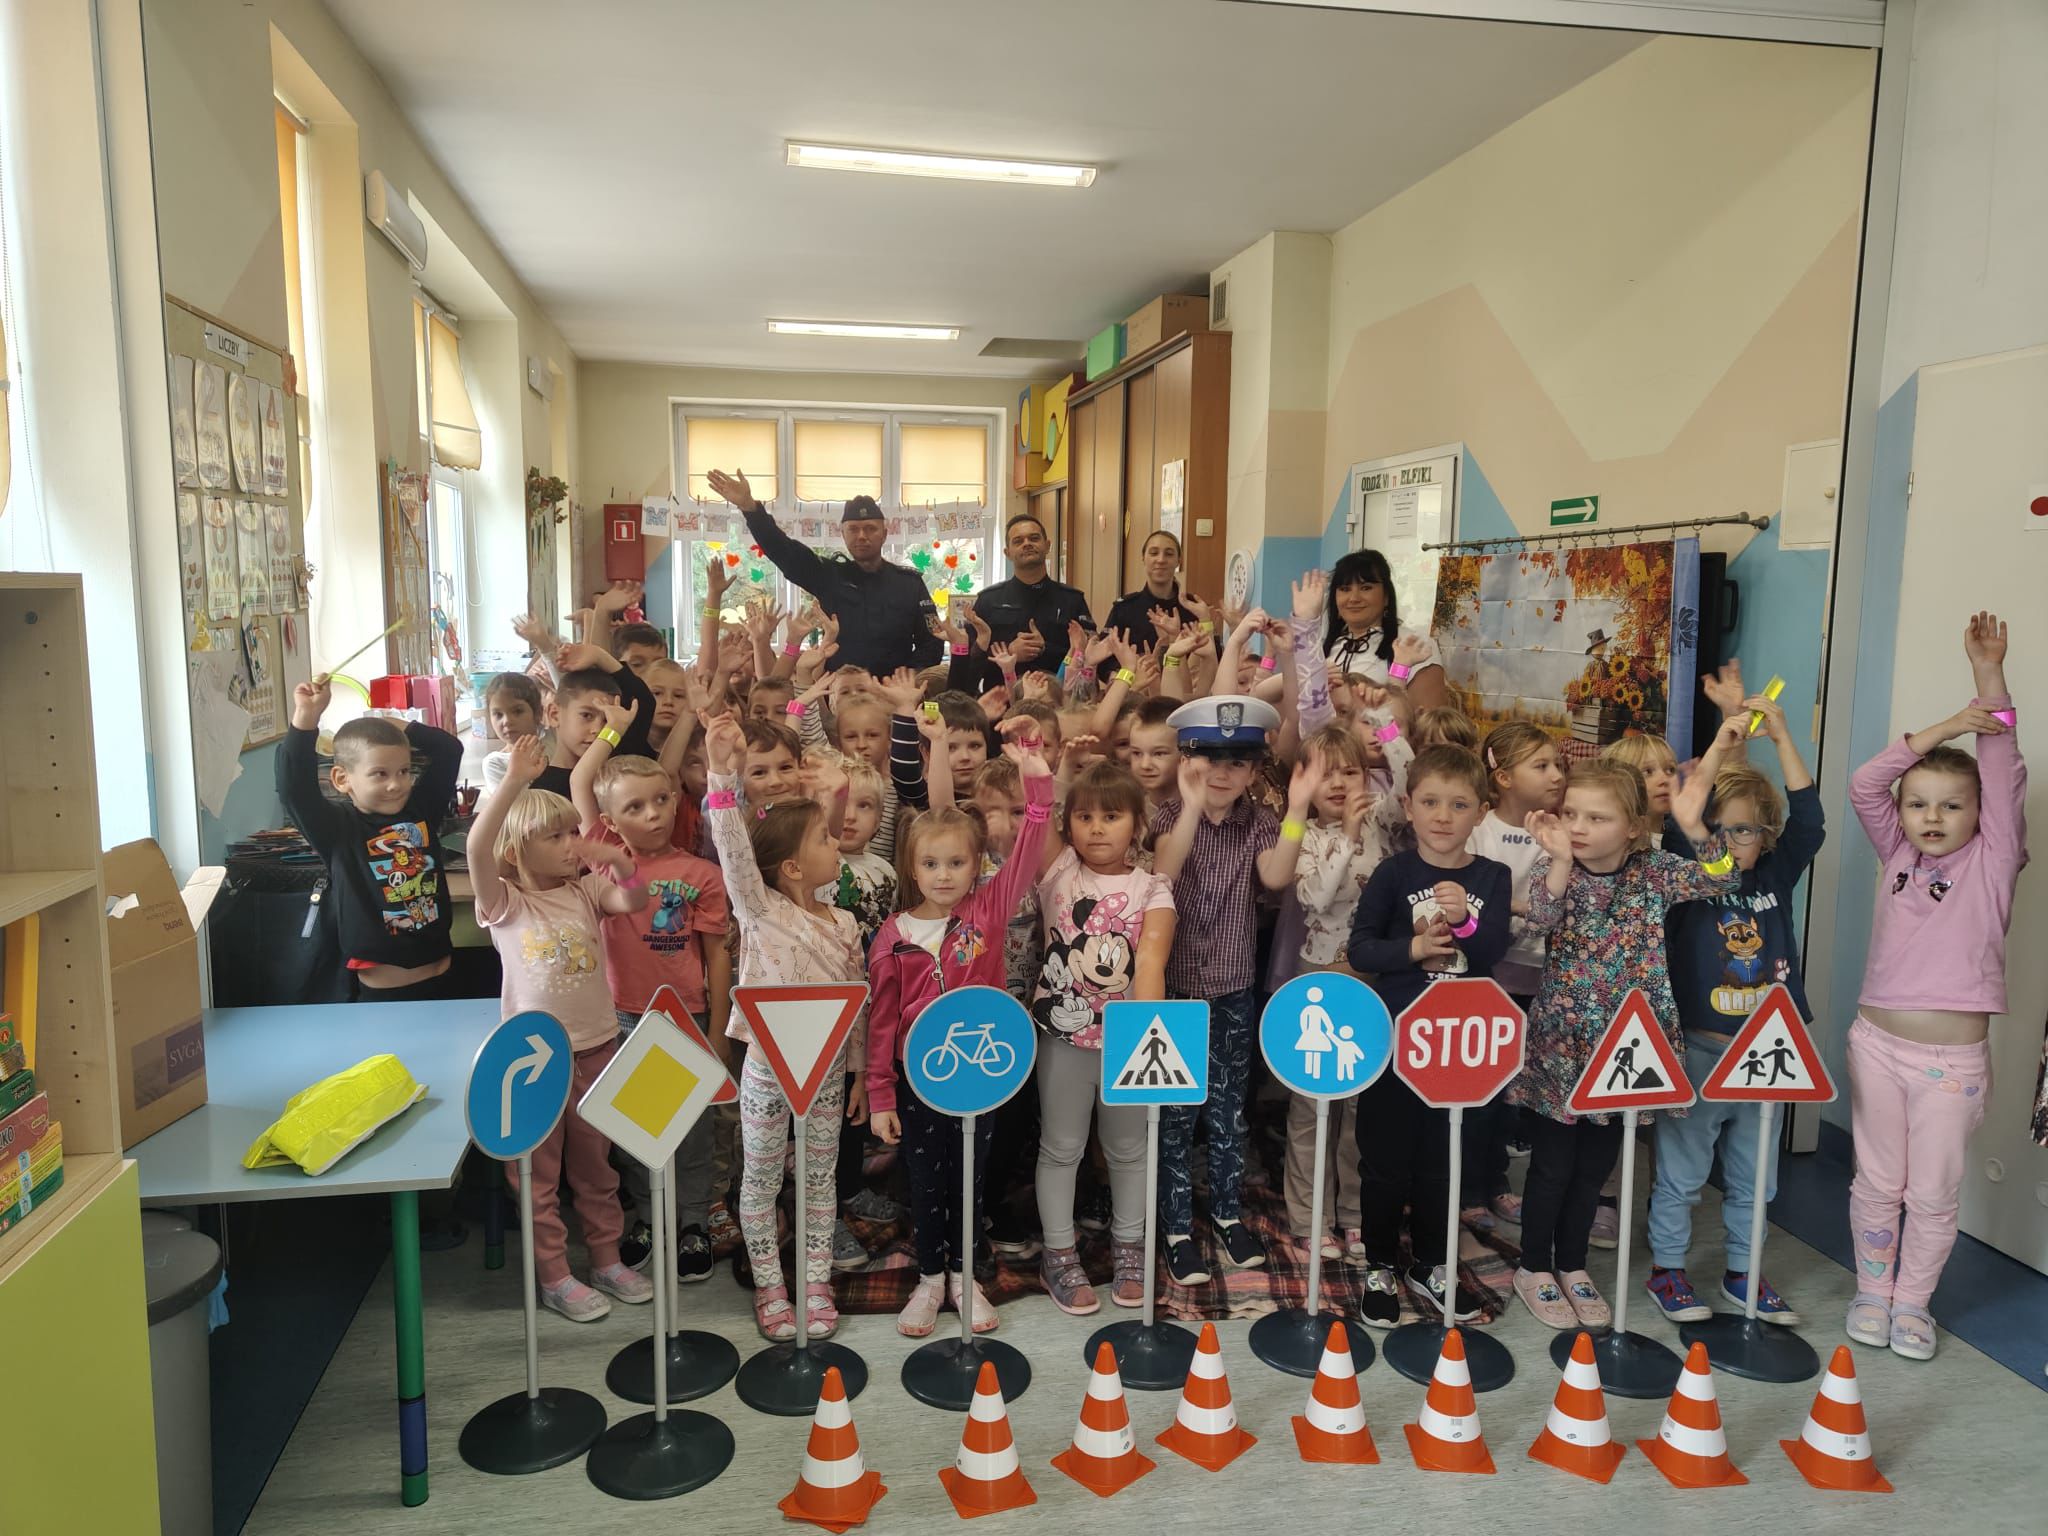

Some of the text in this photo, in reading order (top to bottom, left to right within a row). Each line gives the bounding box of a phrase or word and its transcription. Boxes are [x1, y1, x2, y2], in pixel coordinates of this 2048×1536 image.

[218, 335, 240, 358] LICZBY
[1400, 467, 1431, 485] ELFIKI
[648, 879, 700, 901] STITCH
[1408, 1016, 1516, 1069] STOP
